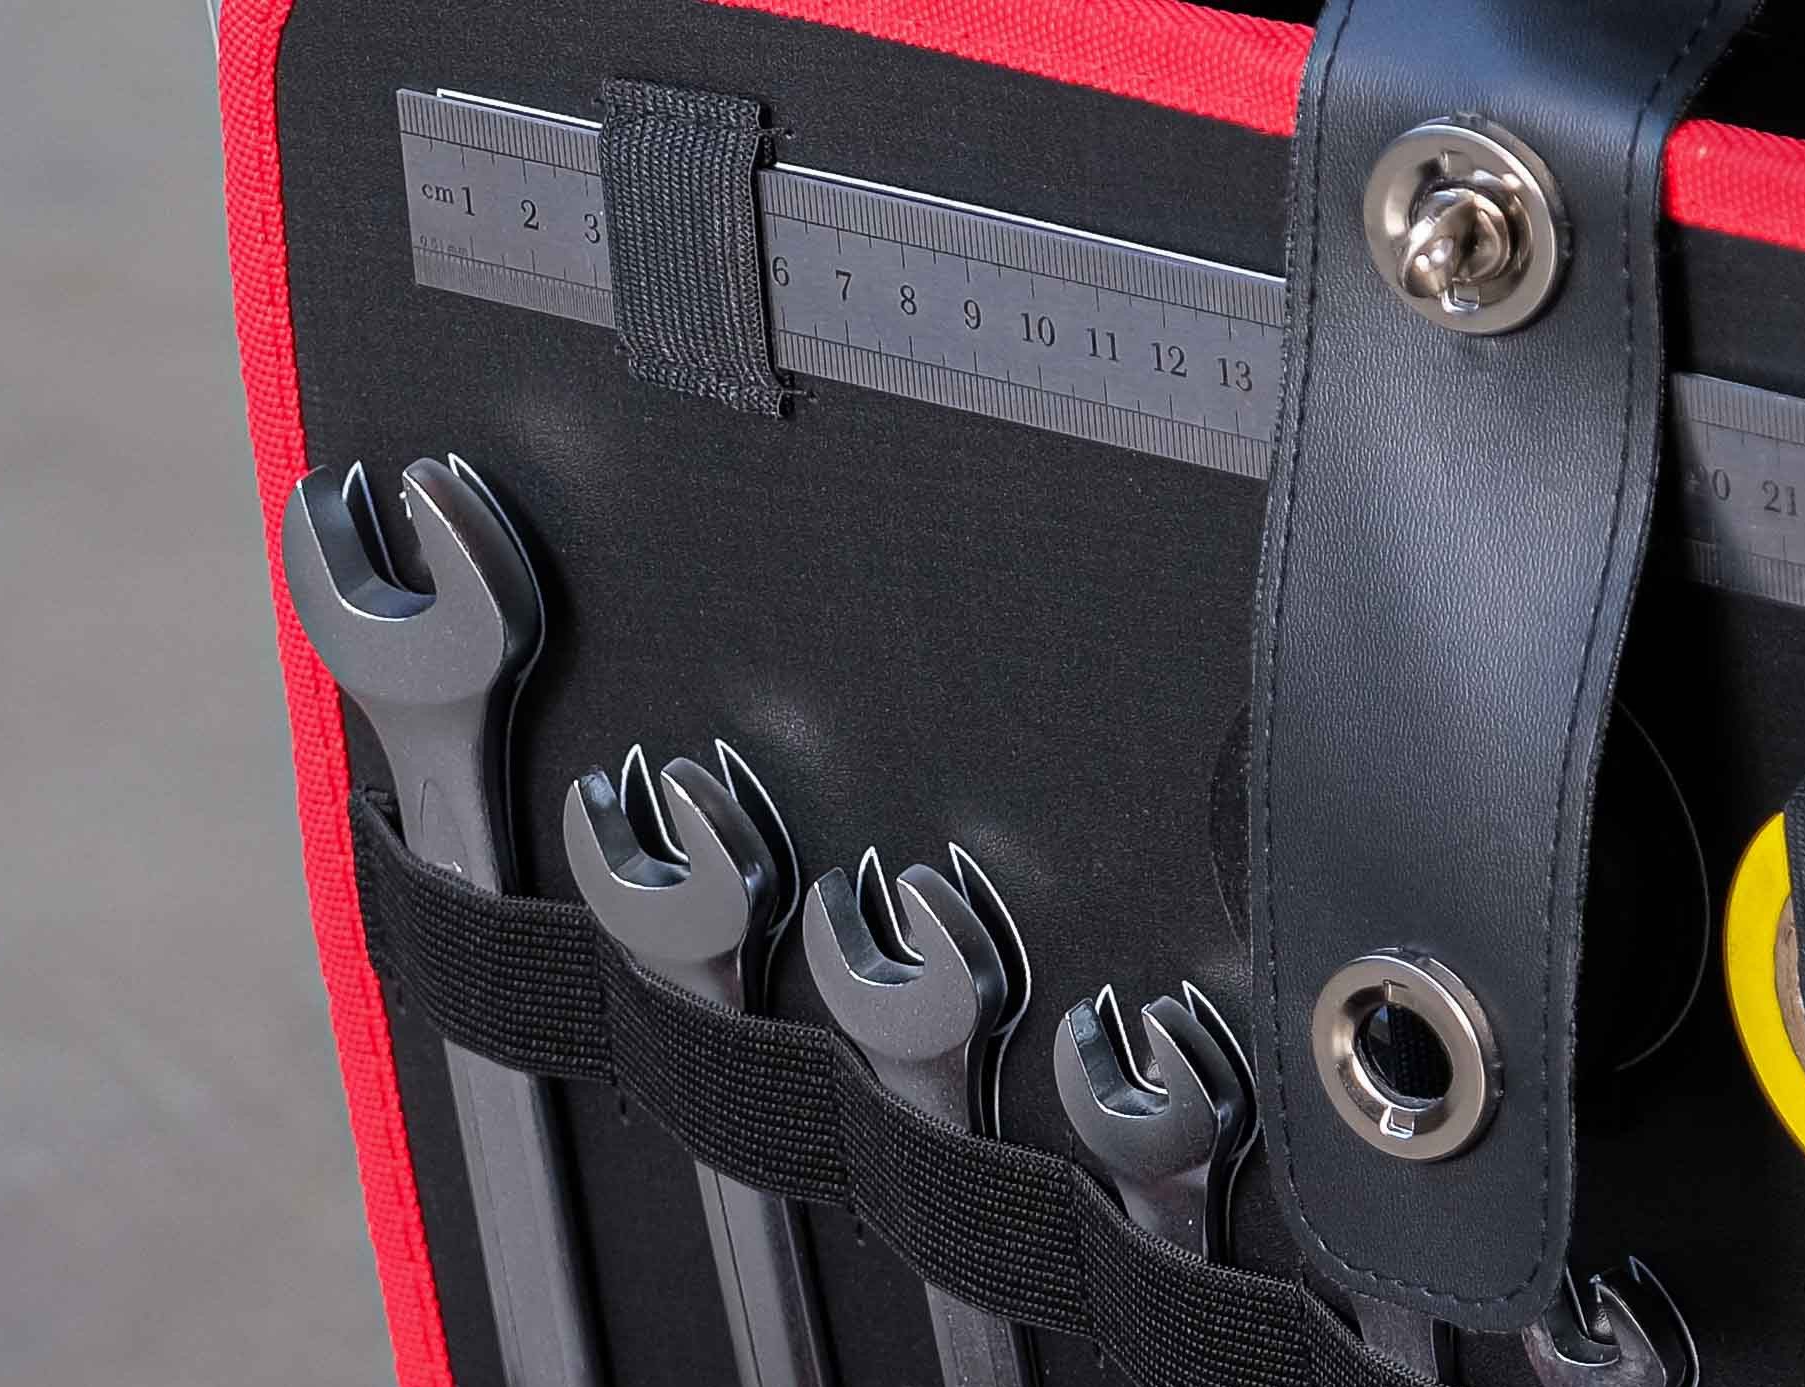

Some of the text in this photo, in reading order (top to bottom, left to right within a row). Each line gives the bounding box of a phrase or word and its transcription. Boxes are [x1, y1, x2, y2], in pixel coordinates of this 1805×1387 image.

[421, 183, 454, 204] cm
[461, 186, 476, 216] 1
[520, 200, 540, 230] 2
[583, 213, 602, 244] 3
[771, 256, 790, 286] 6
[835, 270, 853, 301] 7
[899, 284, 918, 315] 8
[963, 299, 982, 330] 9
[1020, 312, 1056, 347] 10
[1086, 327, 1120, 363] 11
[1150, 341, 1188, 378] 12
[1216, 357, 1253, 393] 13
[1761, 480, 1799, 518] 21
